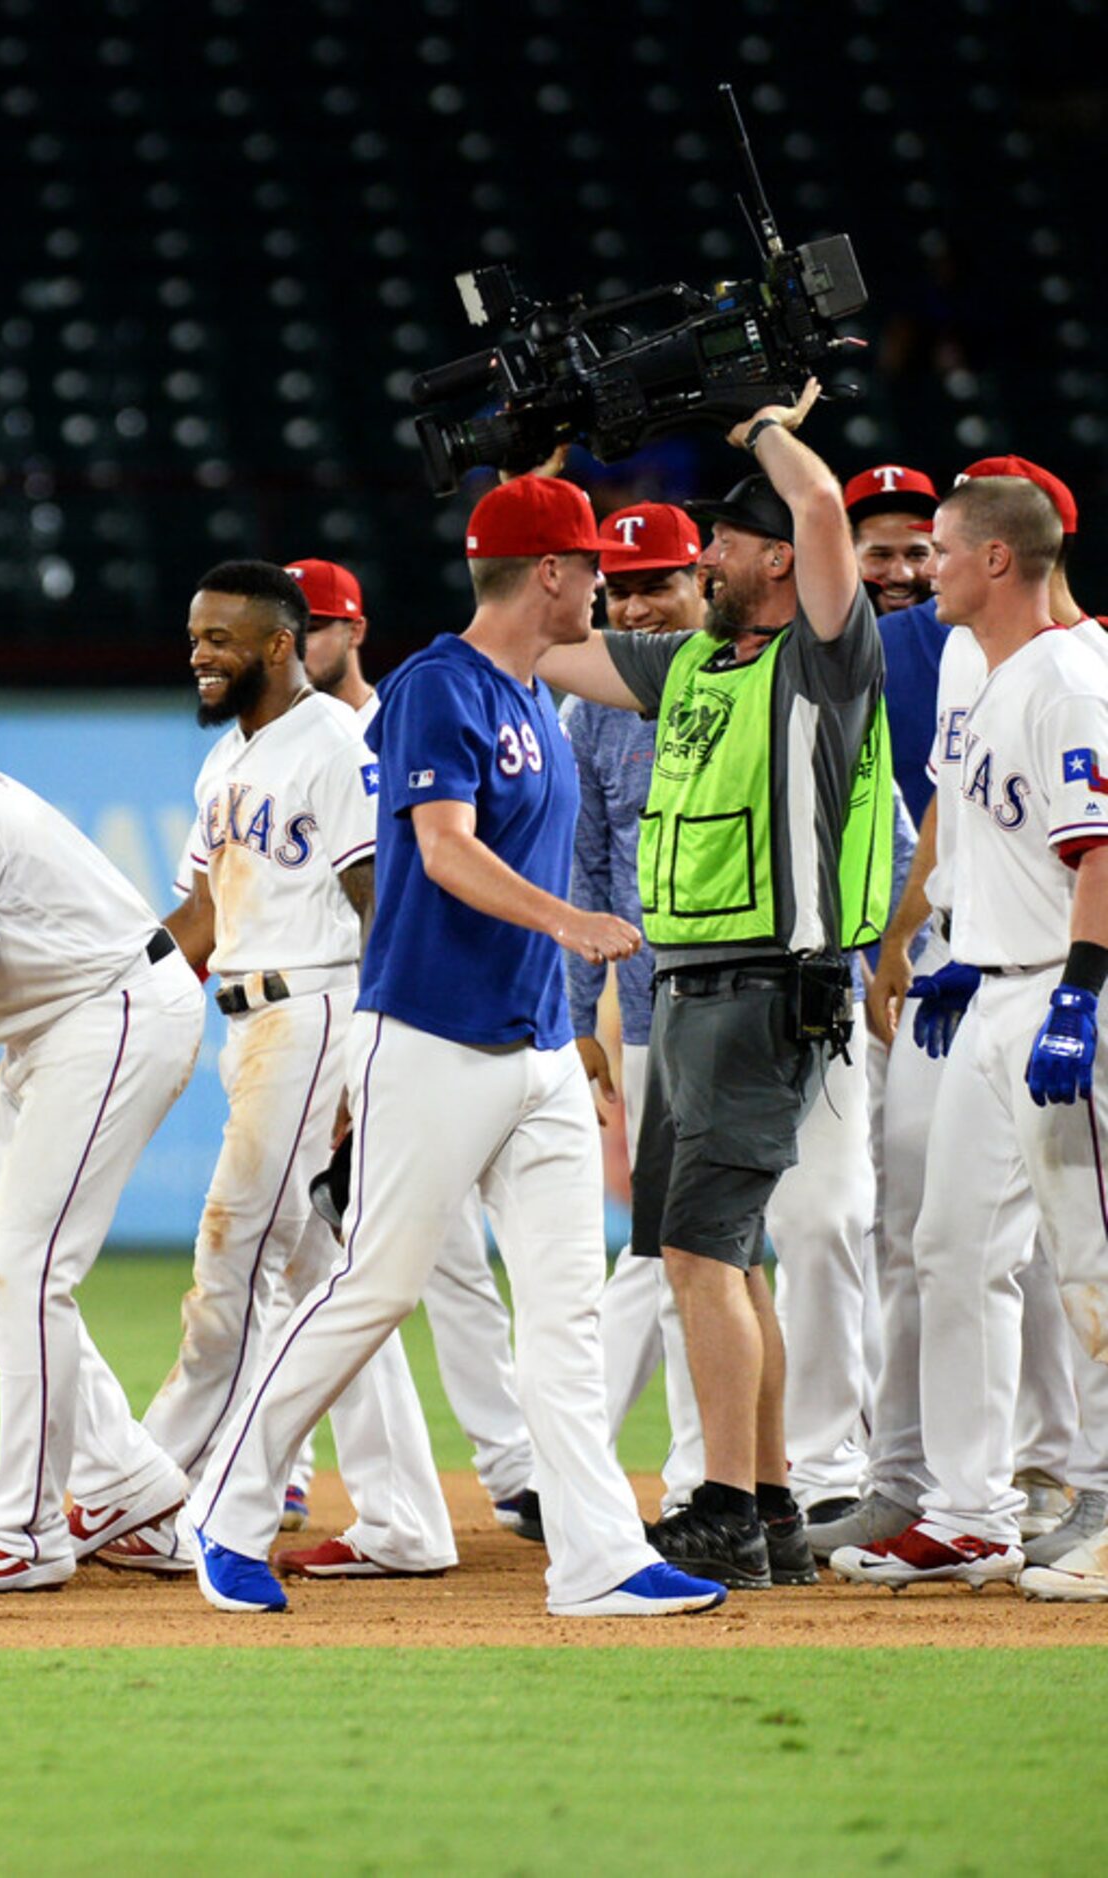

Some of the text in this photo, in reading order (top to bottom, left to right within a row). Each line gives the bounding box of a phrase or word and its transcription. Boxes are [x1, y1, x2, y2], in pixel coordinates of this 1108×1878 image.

[873, 466, 904, 491] T
[615, 516, 644, 546] T
[498, 721, 542, 777] 39
[660, 741, 708, 760] PORTS
[199, 783, 319, 870] EXAS
